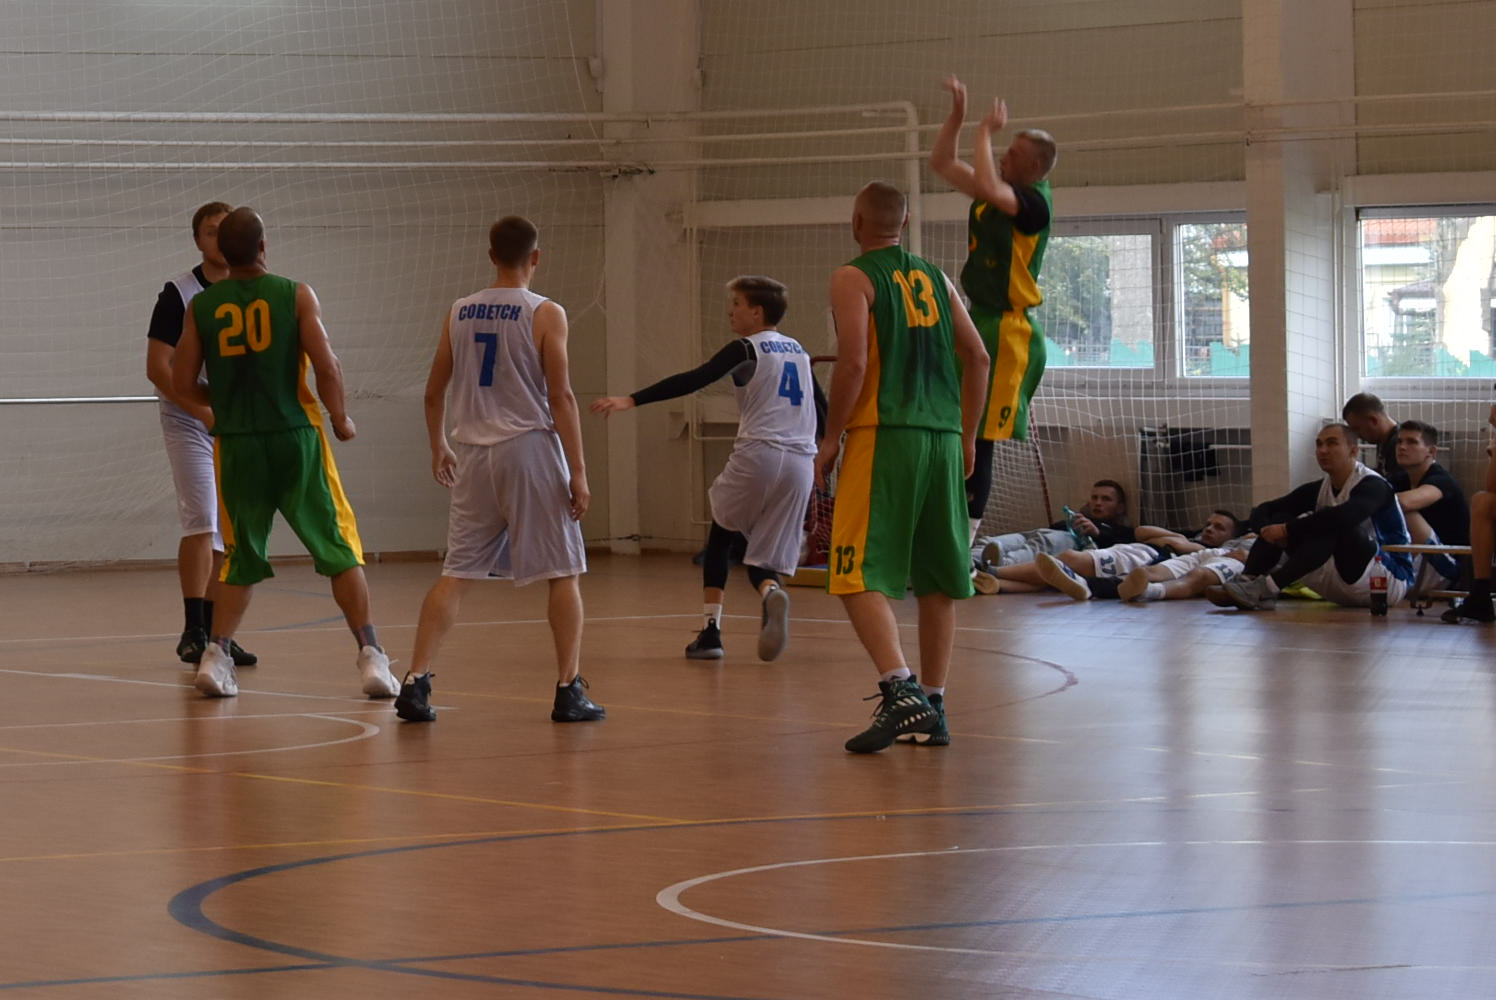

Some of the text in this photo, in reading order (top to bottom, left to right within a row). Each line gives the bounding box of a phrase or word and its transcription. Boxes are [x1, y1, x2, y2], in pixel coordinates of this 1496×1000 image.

[458, 303, 522, 321] СОВЕТСК
[892, 269, 939, 328] 13
[214, 299, 272, 357] 20
[474, 332, 497, 387] 7
[778, 360, 804, 407] 4
[835, 545, 856, 576] 13
